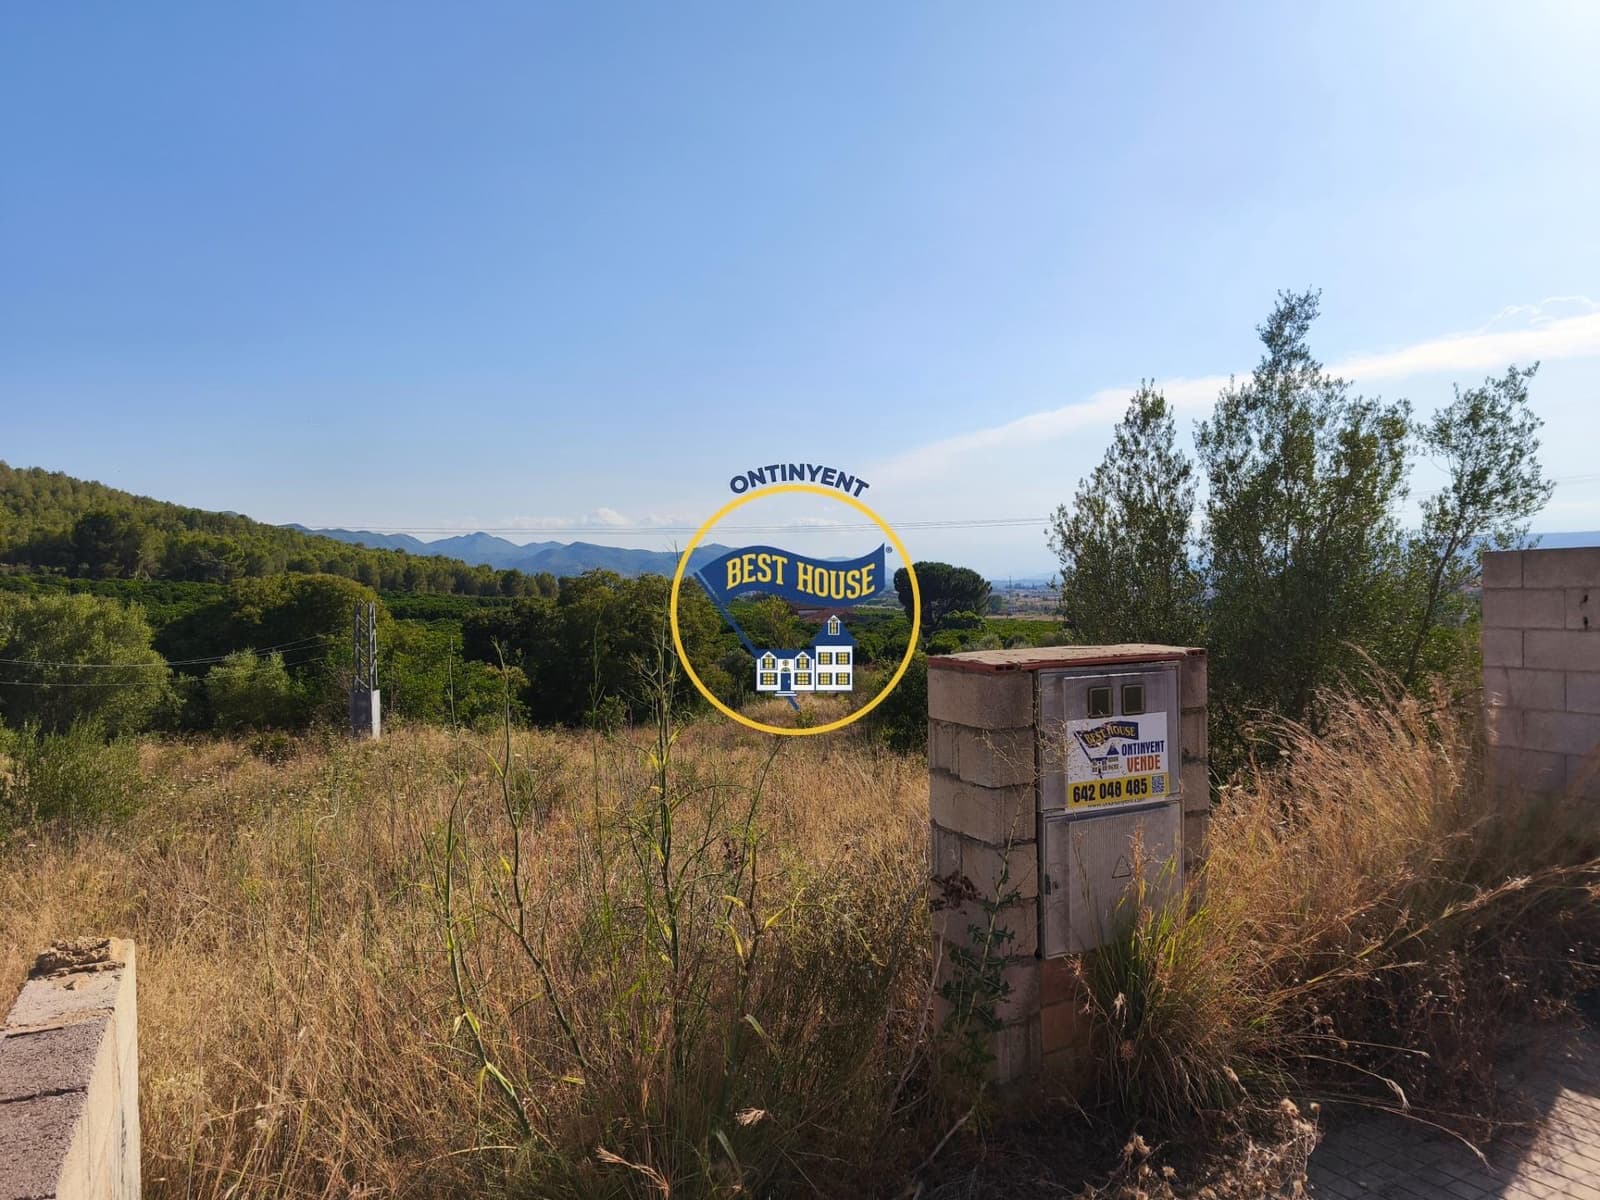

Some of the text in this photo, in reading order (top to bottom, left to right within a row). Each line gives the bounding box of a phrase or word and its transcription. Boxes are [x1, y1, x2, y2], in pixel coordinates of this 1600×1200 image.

[1083, 726, 1135, 745] BEST HOUSE
[1121, 740, 1164, 756] ONTINYENT
[1127, 755, 1160, 773] VENDE
[1073, 784, 1095, 803] 642
[1099, 780, 1121, 799] 048
[1125, 778, 1147, 796] 485
